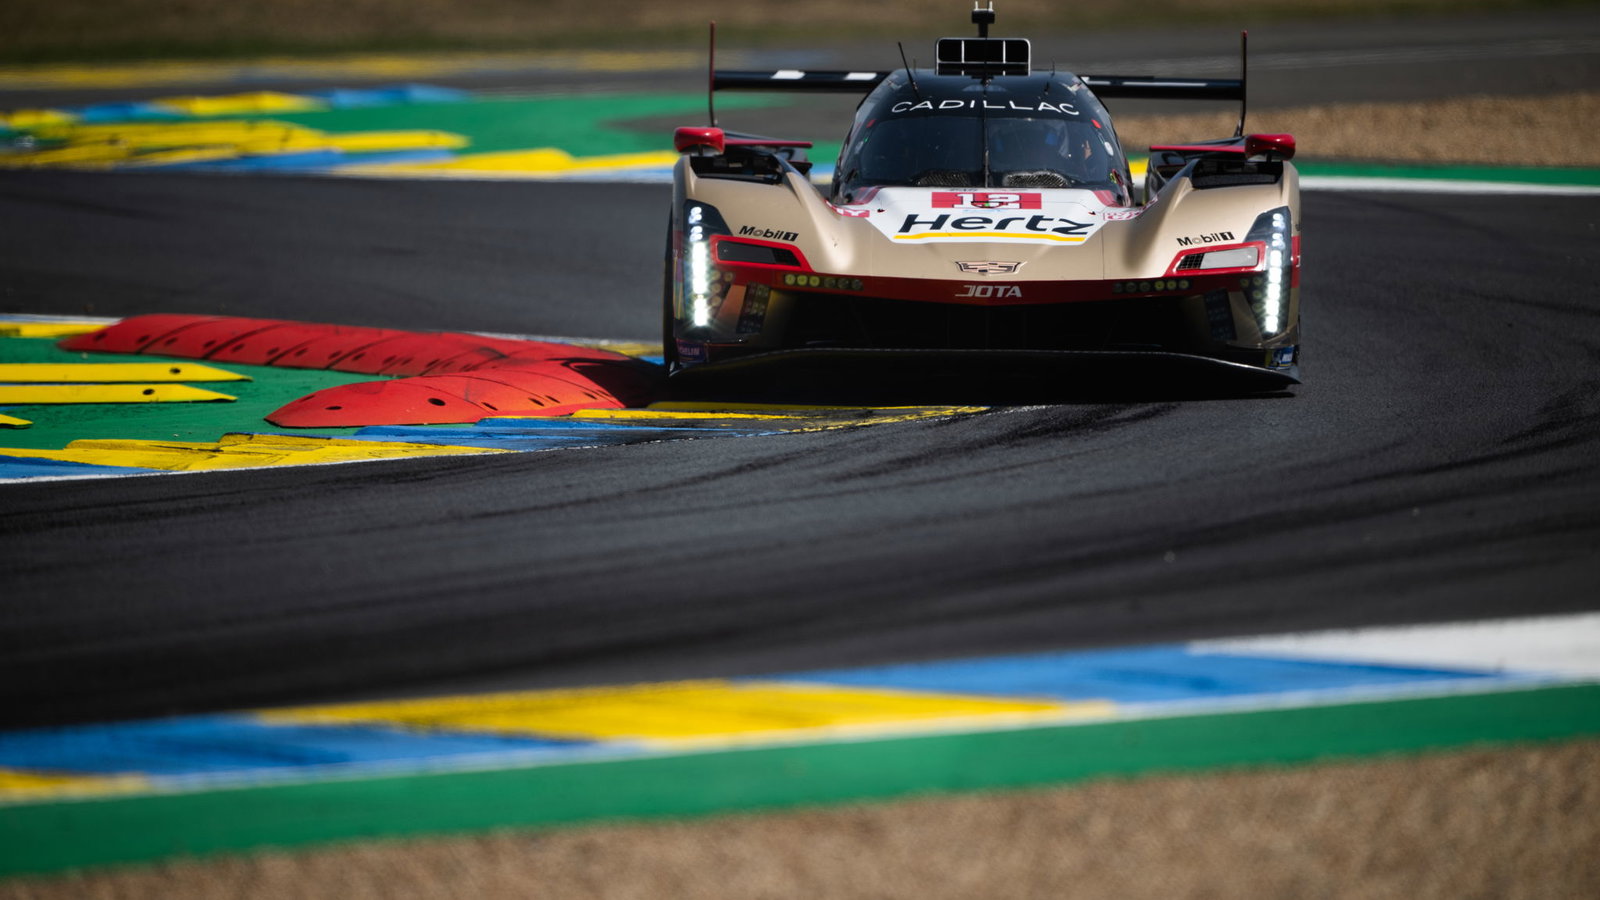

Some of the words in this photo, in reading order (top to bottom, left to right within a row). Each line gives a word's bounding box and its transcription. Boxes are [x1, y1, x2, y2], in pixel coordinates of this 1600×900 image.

[891, 100, 1079, 116] CADILLAC
[898, 214, 1095, 235] Hertz
[955, 284, 1022, 298] JOTA
